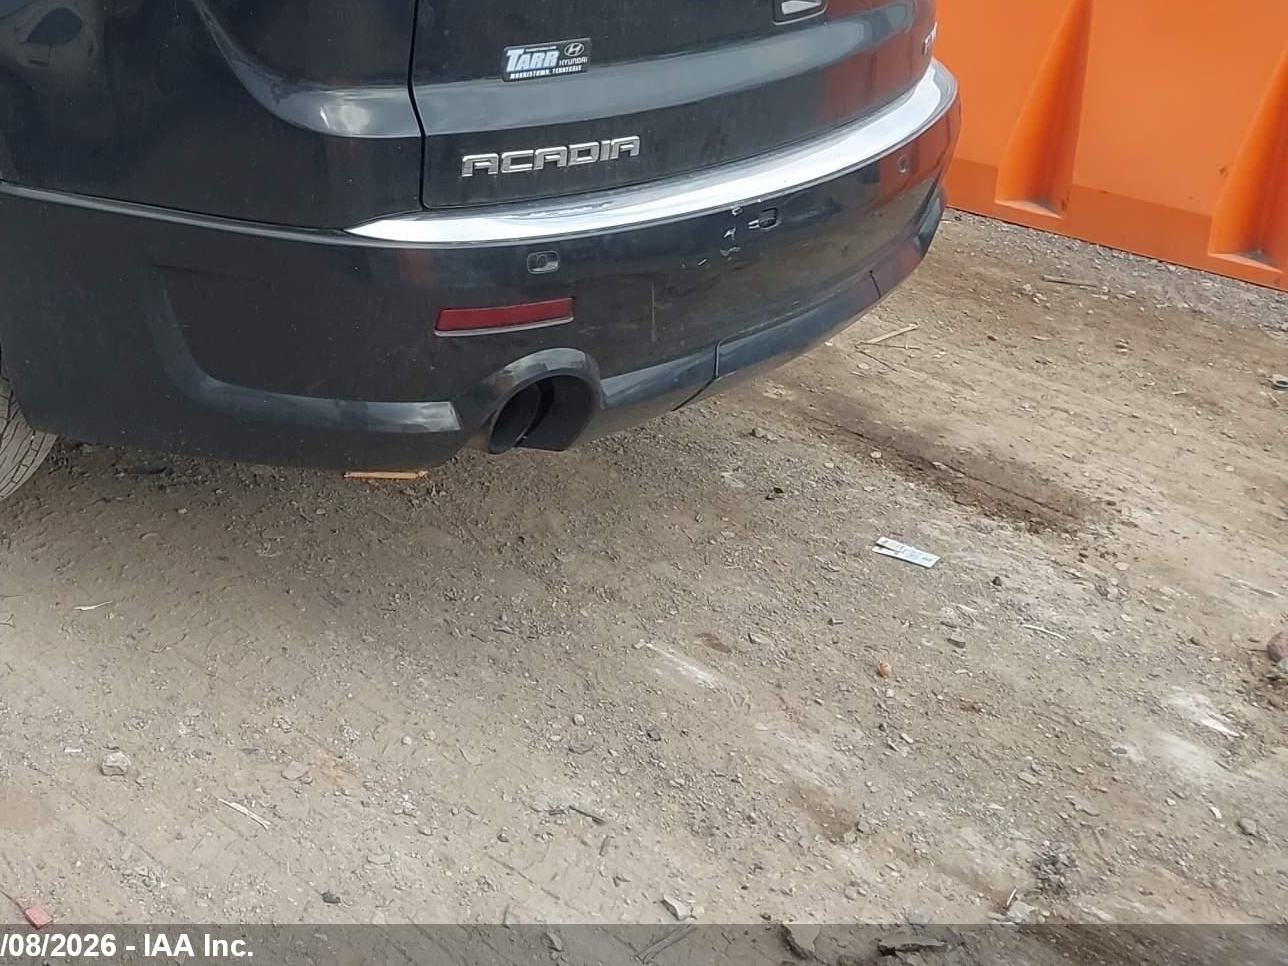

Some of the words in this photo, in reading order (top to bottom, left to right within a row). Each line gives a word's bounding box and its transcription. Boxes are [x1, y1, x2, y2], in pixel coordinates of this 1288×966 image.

[506, 48, 560, 72] TARR
[558, 56, 588, 66] HYUNDAI
[462, 135, 640, 177] ACADIA
